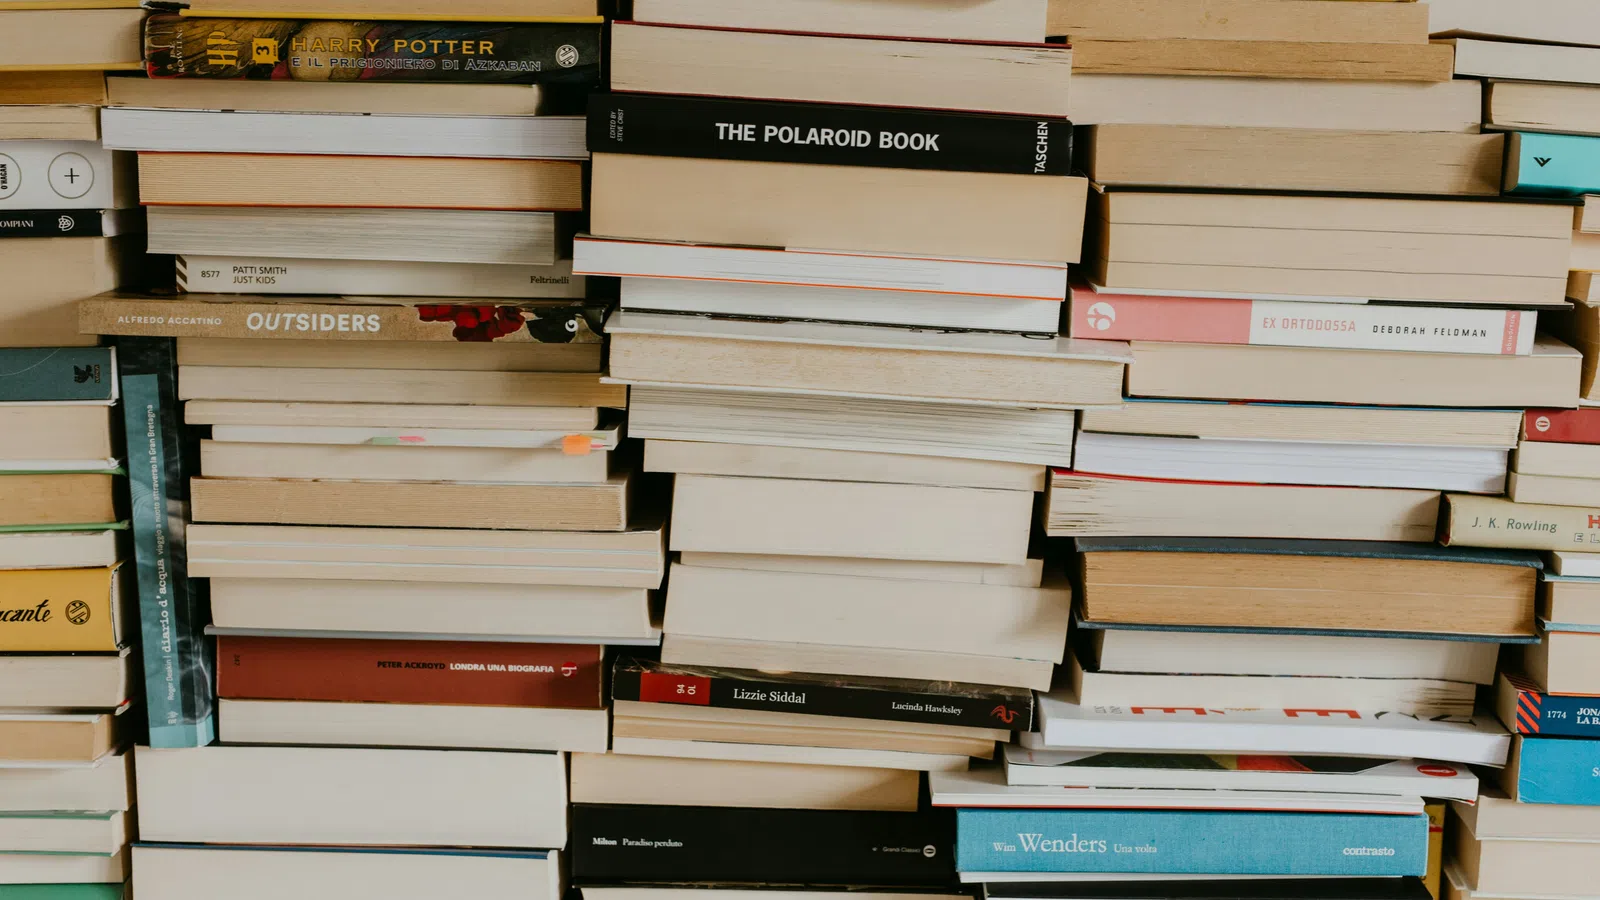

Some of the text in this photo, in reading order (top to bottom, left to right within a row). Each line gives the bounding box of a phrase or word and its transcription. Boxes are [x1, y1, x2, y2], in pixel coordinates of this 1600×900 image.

[206, 31, 242, 66] HP
[291, 37, 379, 53] HARRY
[394, 39, 495, 55] POTTER
[291, 57, 542, 72] E IL PRIGIONIERO DI AZKABAN
[610, 110, 617, 119] BY
[715, 122, 940, 151] THE POLAROID BOOK
[1034, 121, 1048, 173] TASCHEN
[232, 266, 287, 275] PATTI SMITH
[232, 276, 276, 284] JUST KIDS
[530, 276, 570, 284] Feltrinelli
[118, 316, 222, 326] ALFREDO ACCATINO
[246, 312, 381, 332] OUTSIDERS
[1262, 318, 1488, 338] EX ORTODOSSA DEBORAH FELDMAN
[146, 404, 156, 437] Bretagna
[148, 438, 156, 456] Gran
[151, 464, 160, 501] attraverso
[1472, 517, 1558, 534] J. K. Rowling
[156, 530, 164, 555] viaggio
[1574, 532, 1584, 542] E
[156, 558, 168, 608] d'acqua
[160, 610, 172, 653] diario
[166, 659, 174, 682] Deakin
[376, 660, 554, 674] PETER ACKROYD LONDRA UNA BIOGRAFIA
[167, 682, 176, 701] Roger
[734, 688, 806, 704] Lizzie Siddal
[892, 702, 962, 716] Lucinda Hawksley
[1547, 710, 1566, 719] 1774
[1576, 716, 1590, 724] LA
[592, 838, 683, 848] Milton Paradiso perduto
[992, 833, 1158, 853] Wim Wenders Una volta
[1342, 846, 1395, 856] contrasto
